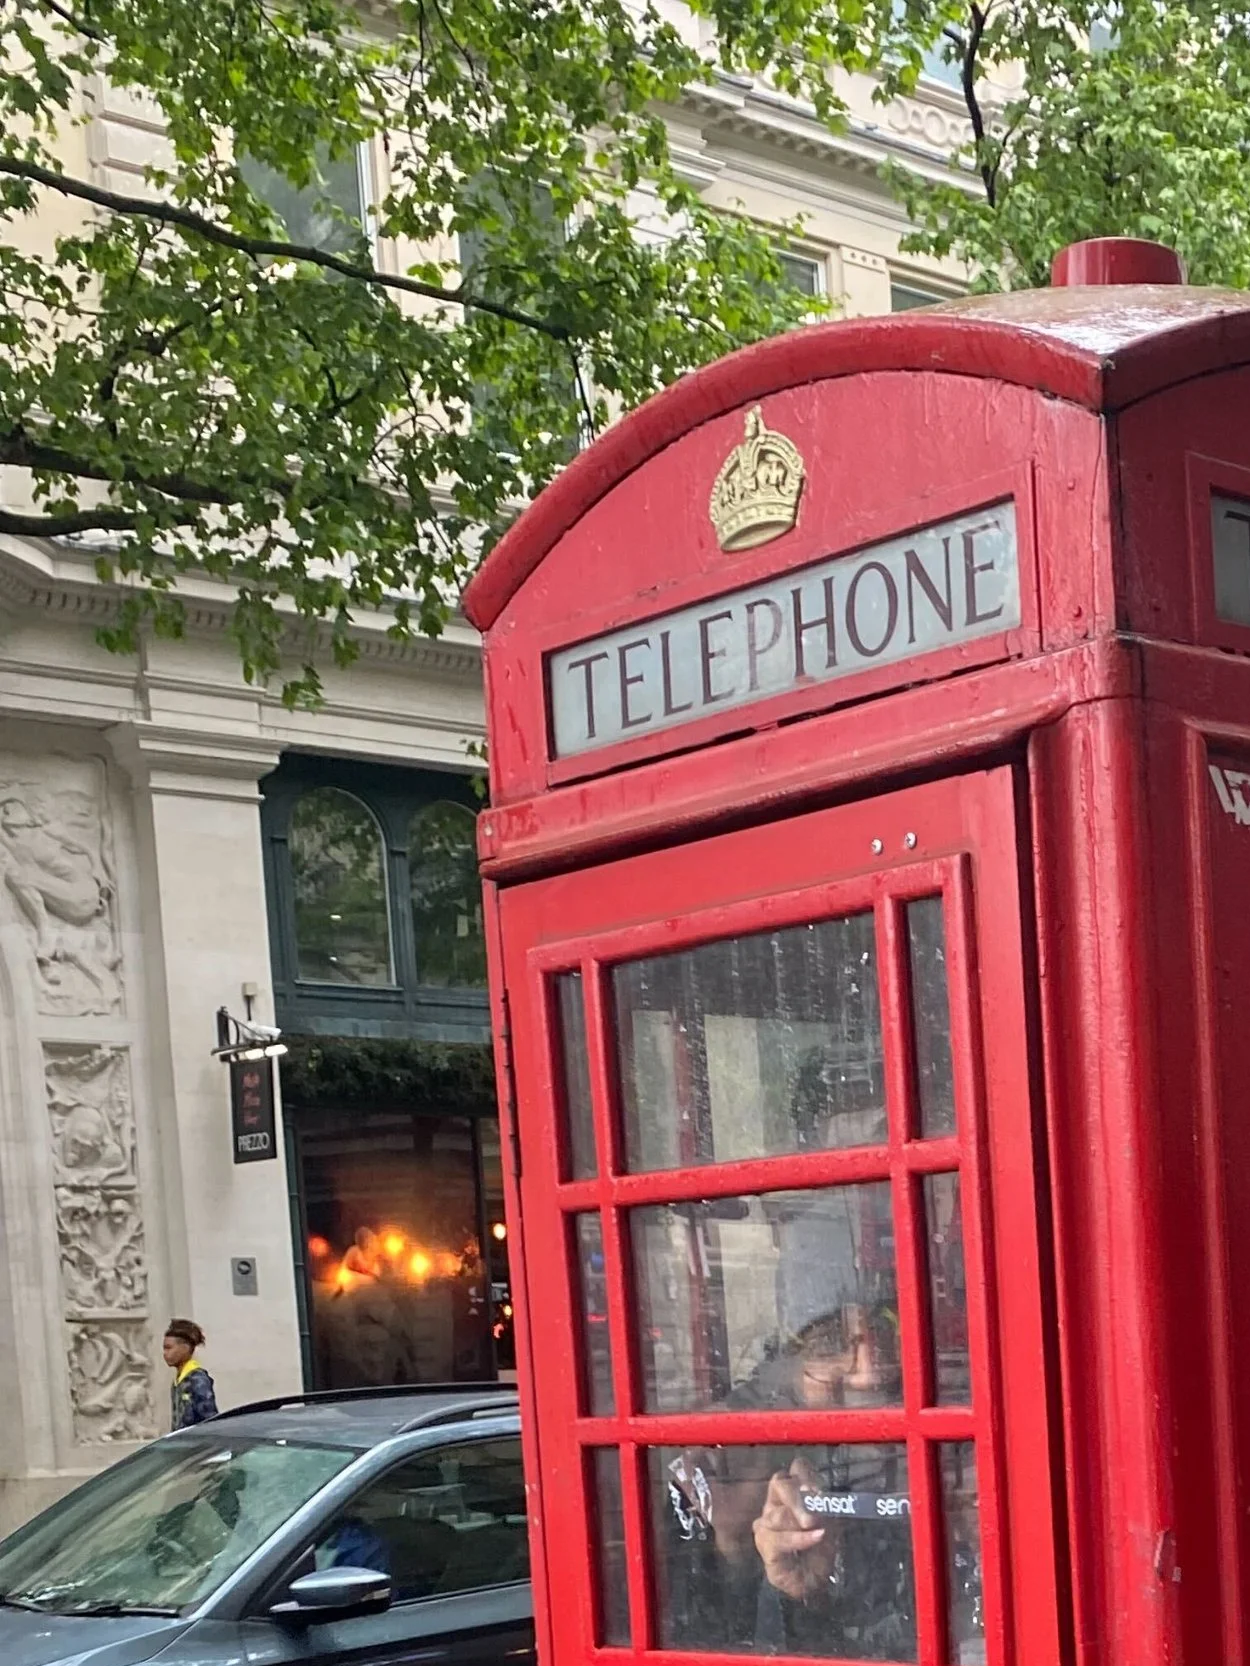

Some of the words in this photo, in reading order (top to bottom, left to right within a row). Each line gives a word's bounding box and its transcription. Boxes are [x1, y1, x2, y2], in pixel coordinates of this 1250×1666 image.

[568, 521, 1004, 739] TELEPHONE
[804, 1494, 856, 1514] sensat
[876, 1498, 912, 1516] sen
